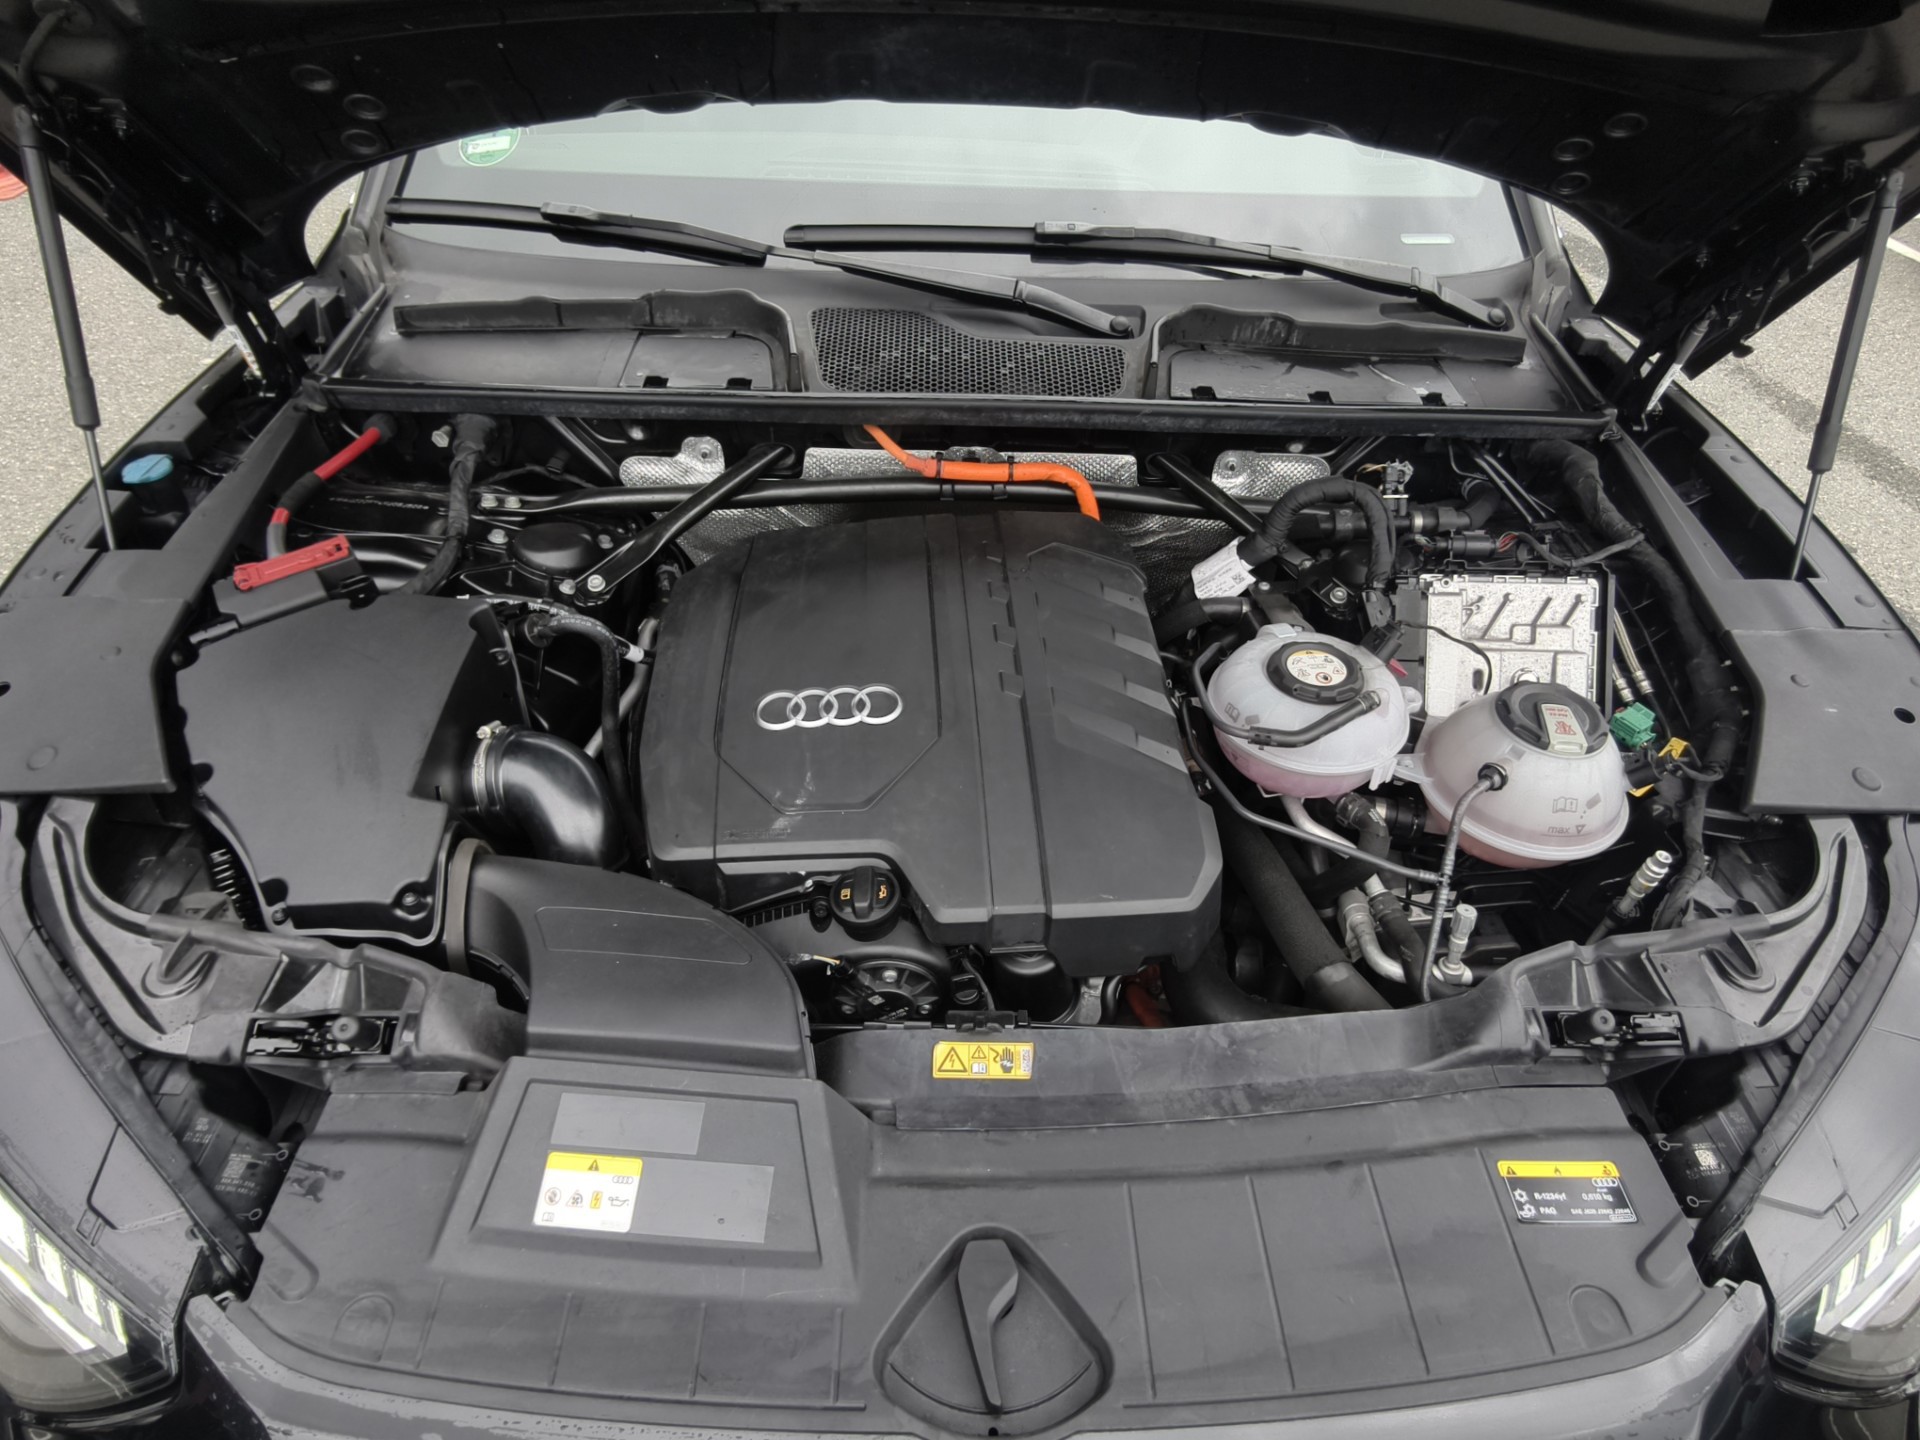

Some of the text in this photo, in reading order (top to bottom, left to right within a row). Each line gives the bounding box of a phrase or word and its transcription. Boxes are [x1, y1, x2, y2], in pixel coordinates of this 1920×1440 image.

[1547, 826, 1571, 834] max
[1534, 1192, 1567, 1201] R-1234yf
[1602, 1193, 1613, 1202] kg
